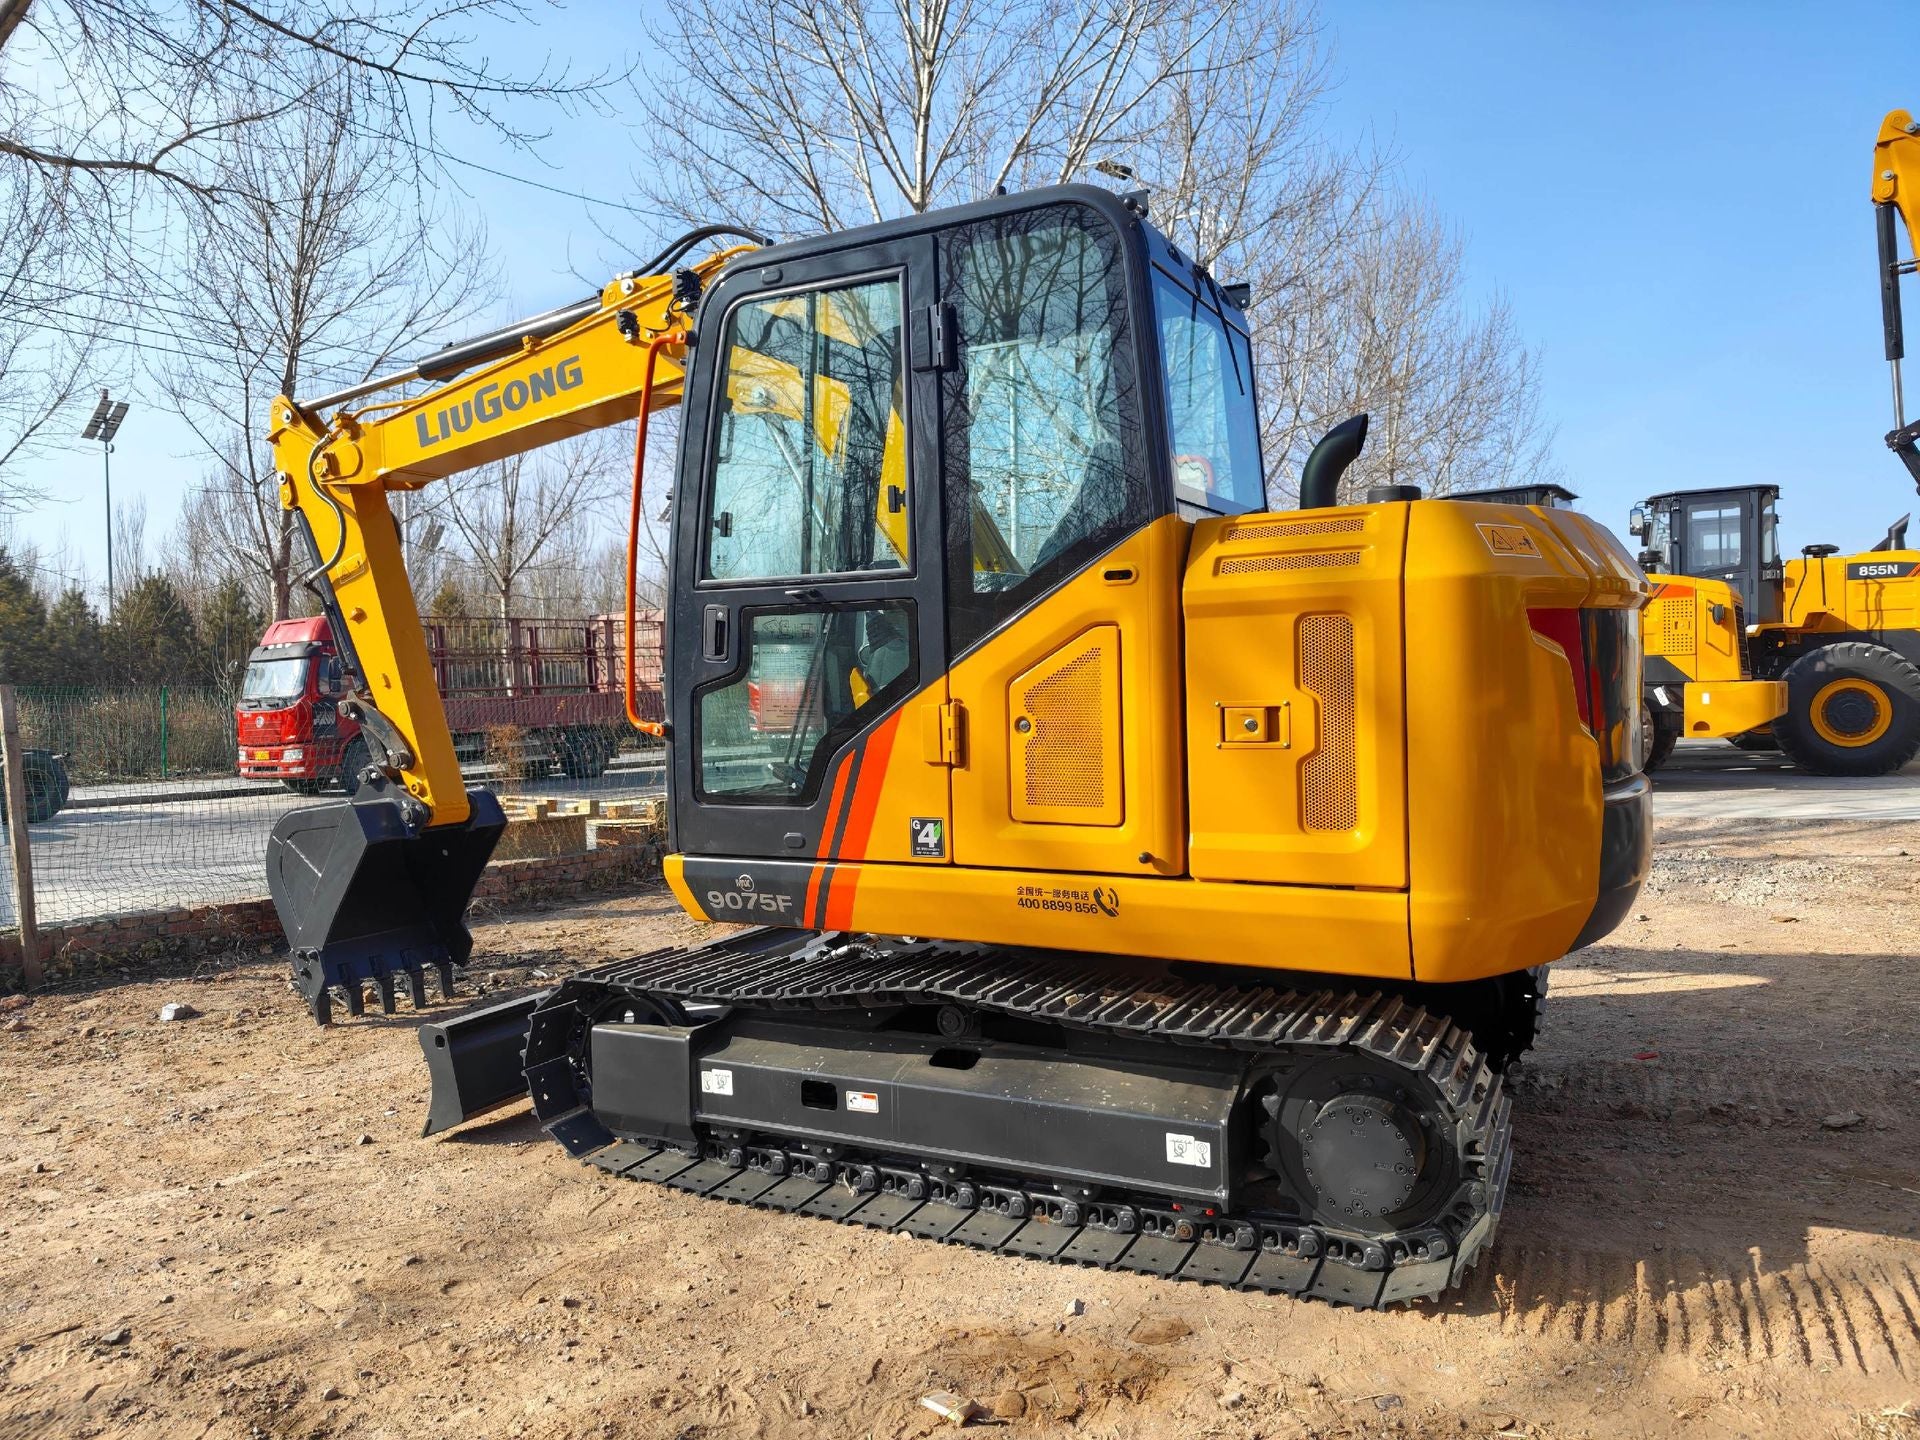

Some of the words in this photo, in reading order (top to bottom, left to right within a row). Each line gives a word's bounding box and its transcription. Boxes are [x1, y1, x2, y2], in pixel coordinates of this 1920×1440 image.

[415, 355, 584, 448] LIUGONG
[1859, 564, 1898, 576] 855N
[707, 890, 792, 913] 9075F
[1017, 886, 1090, 901] 全国统一服务电话
[1017, 898, 1040, 909] 400
[1042, 899, 1073, 912] 8899
[1075, 902, 1098, 914] 856
